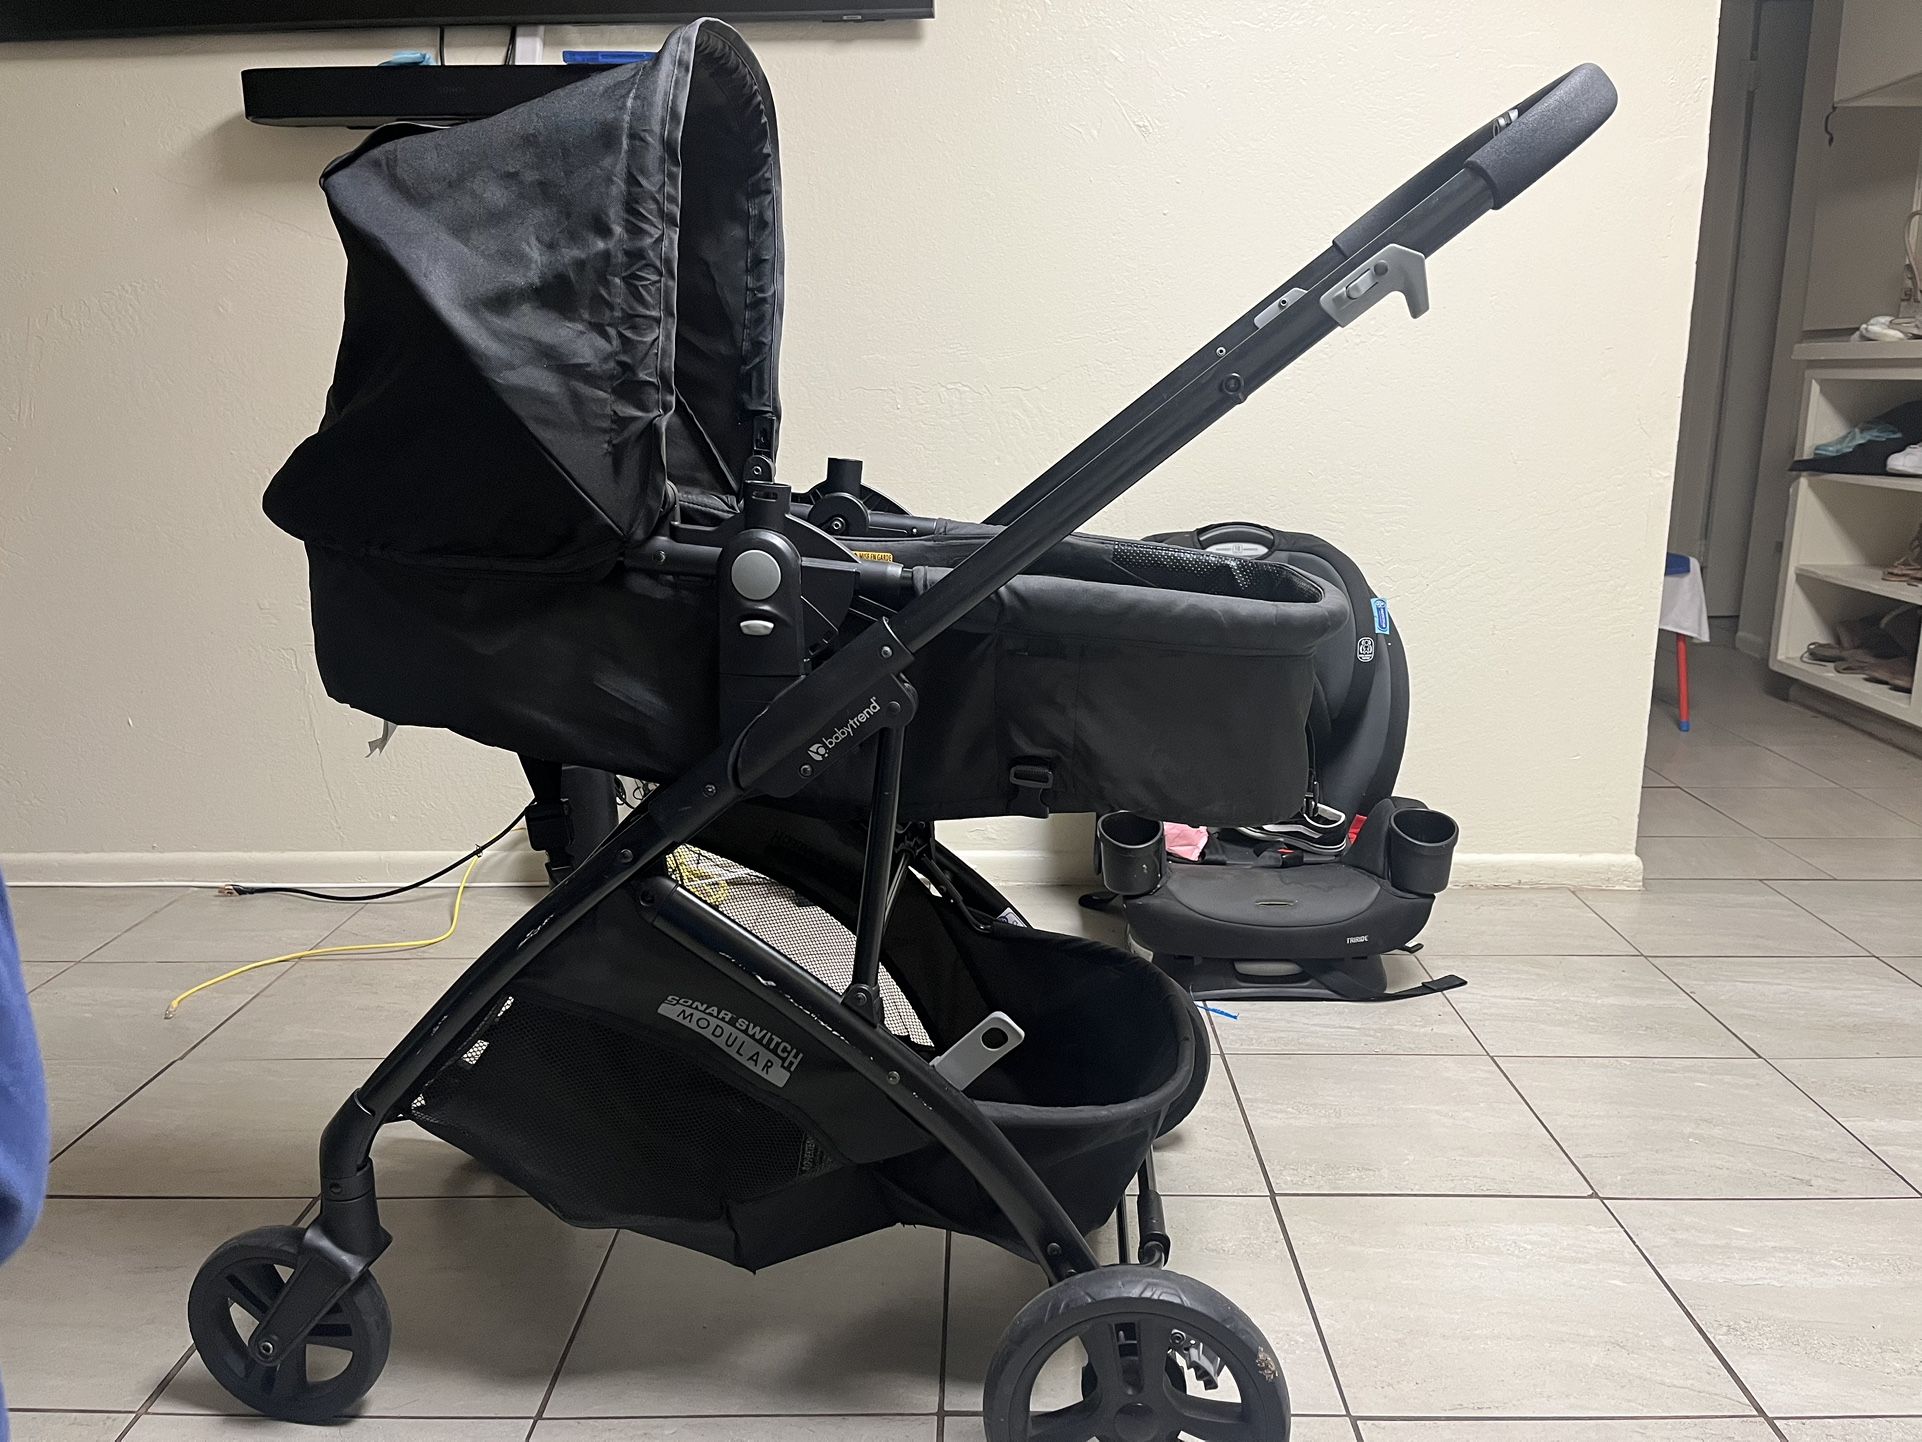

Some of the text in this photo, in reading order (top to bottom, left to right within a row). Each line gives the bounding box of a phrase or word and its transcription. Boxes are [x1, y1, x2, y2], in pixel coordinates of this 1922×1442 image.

[822, 697, 881, 748] babytrend
[664, 995, 804, 1072] SONAR SWITCH
[676, 1009, 774, 1075] MODULAR
